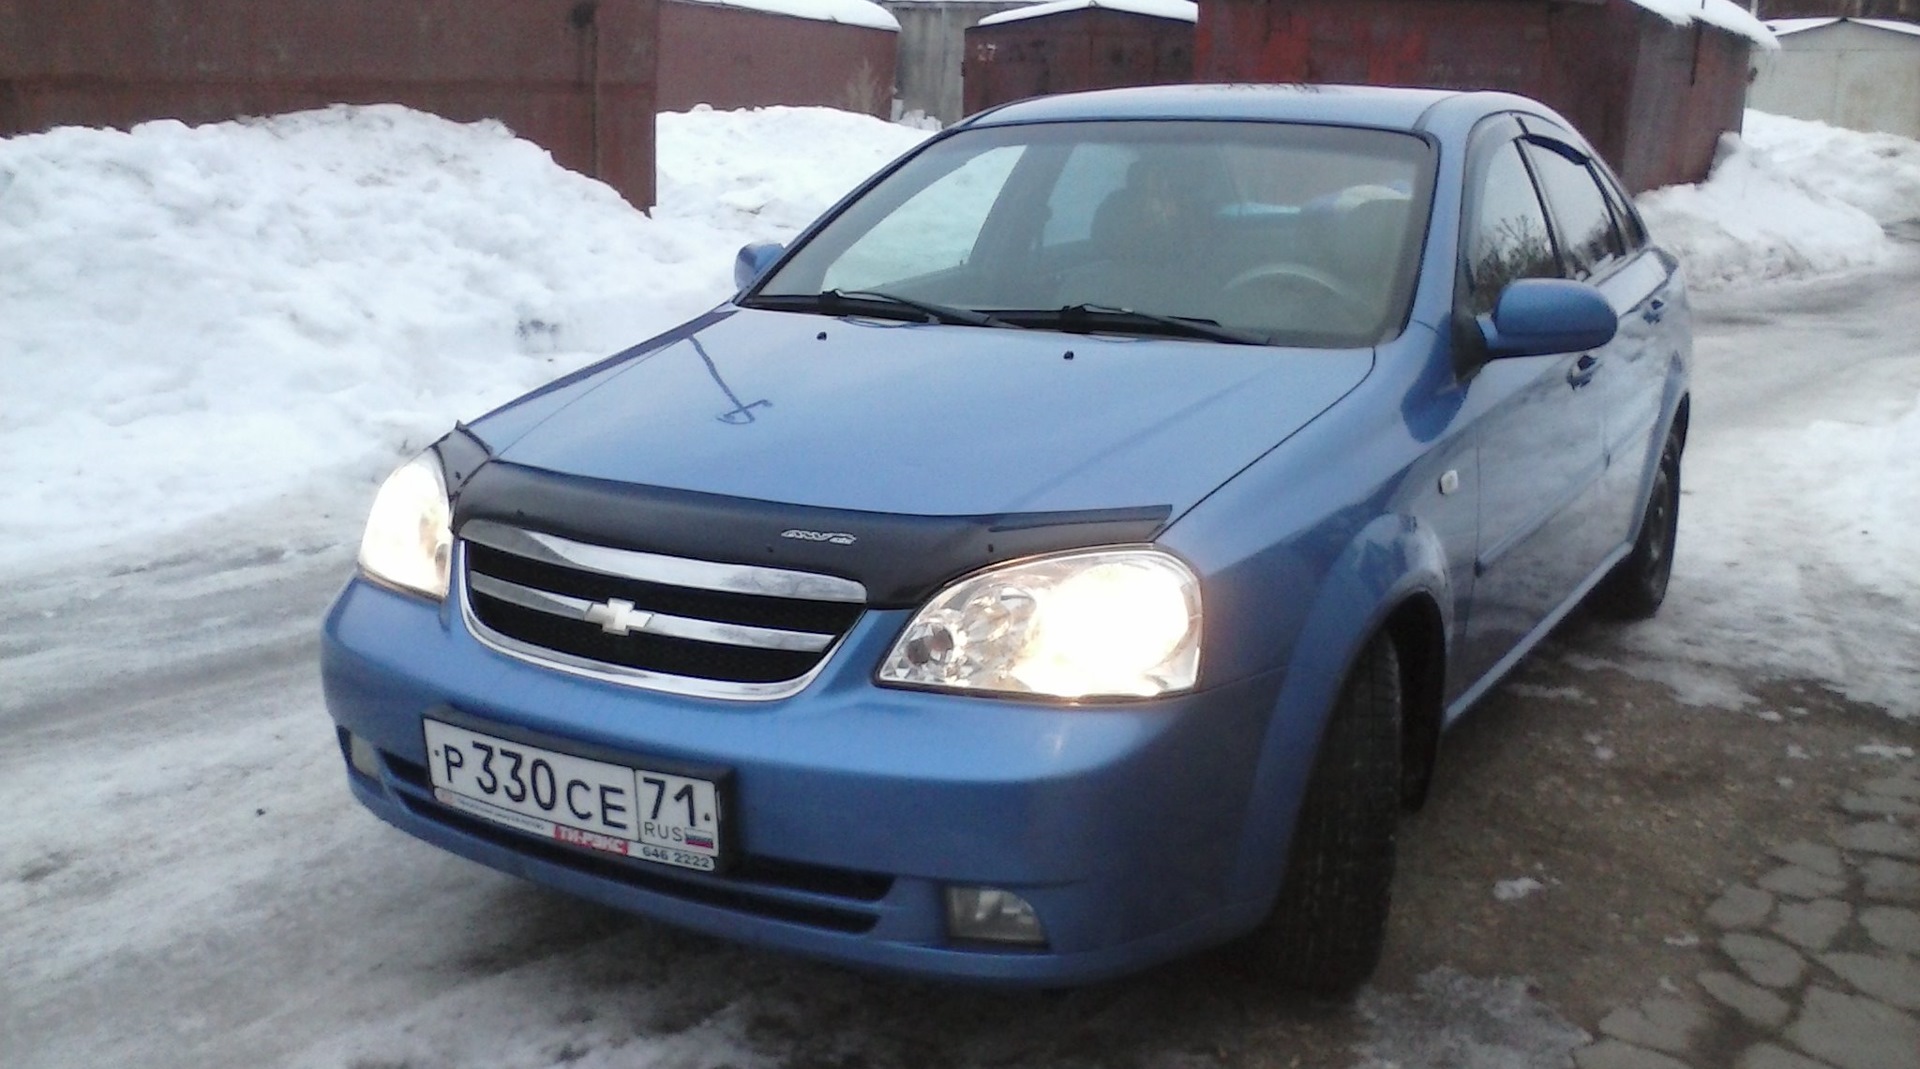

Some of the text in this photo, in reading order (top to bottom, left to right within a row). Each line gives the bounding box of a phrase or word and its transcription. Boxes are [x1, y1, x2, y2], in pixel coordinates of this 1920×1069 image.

[443, 740, 627, 830] P330CE
[642, 777, 697, 827] 71
[644, 821, 683, 842] RUS
[642, 841, 710, 868] 646 2222
